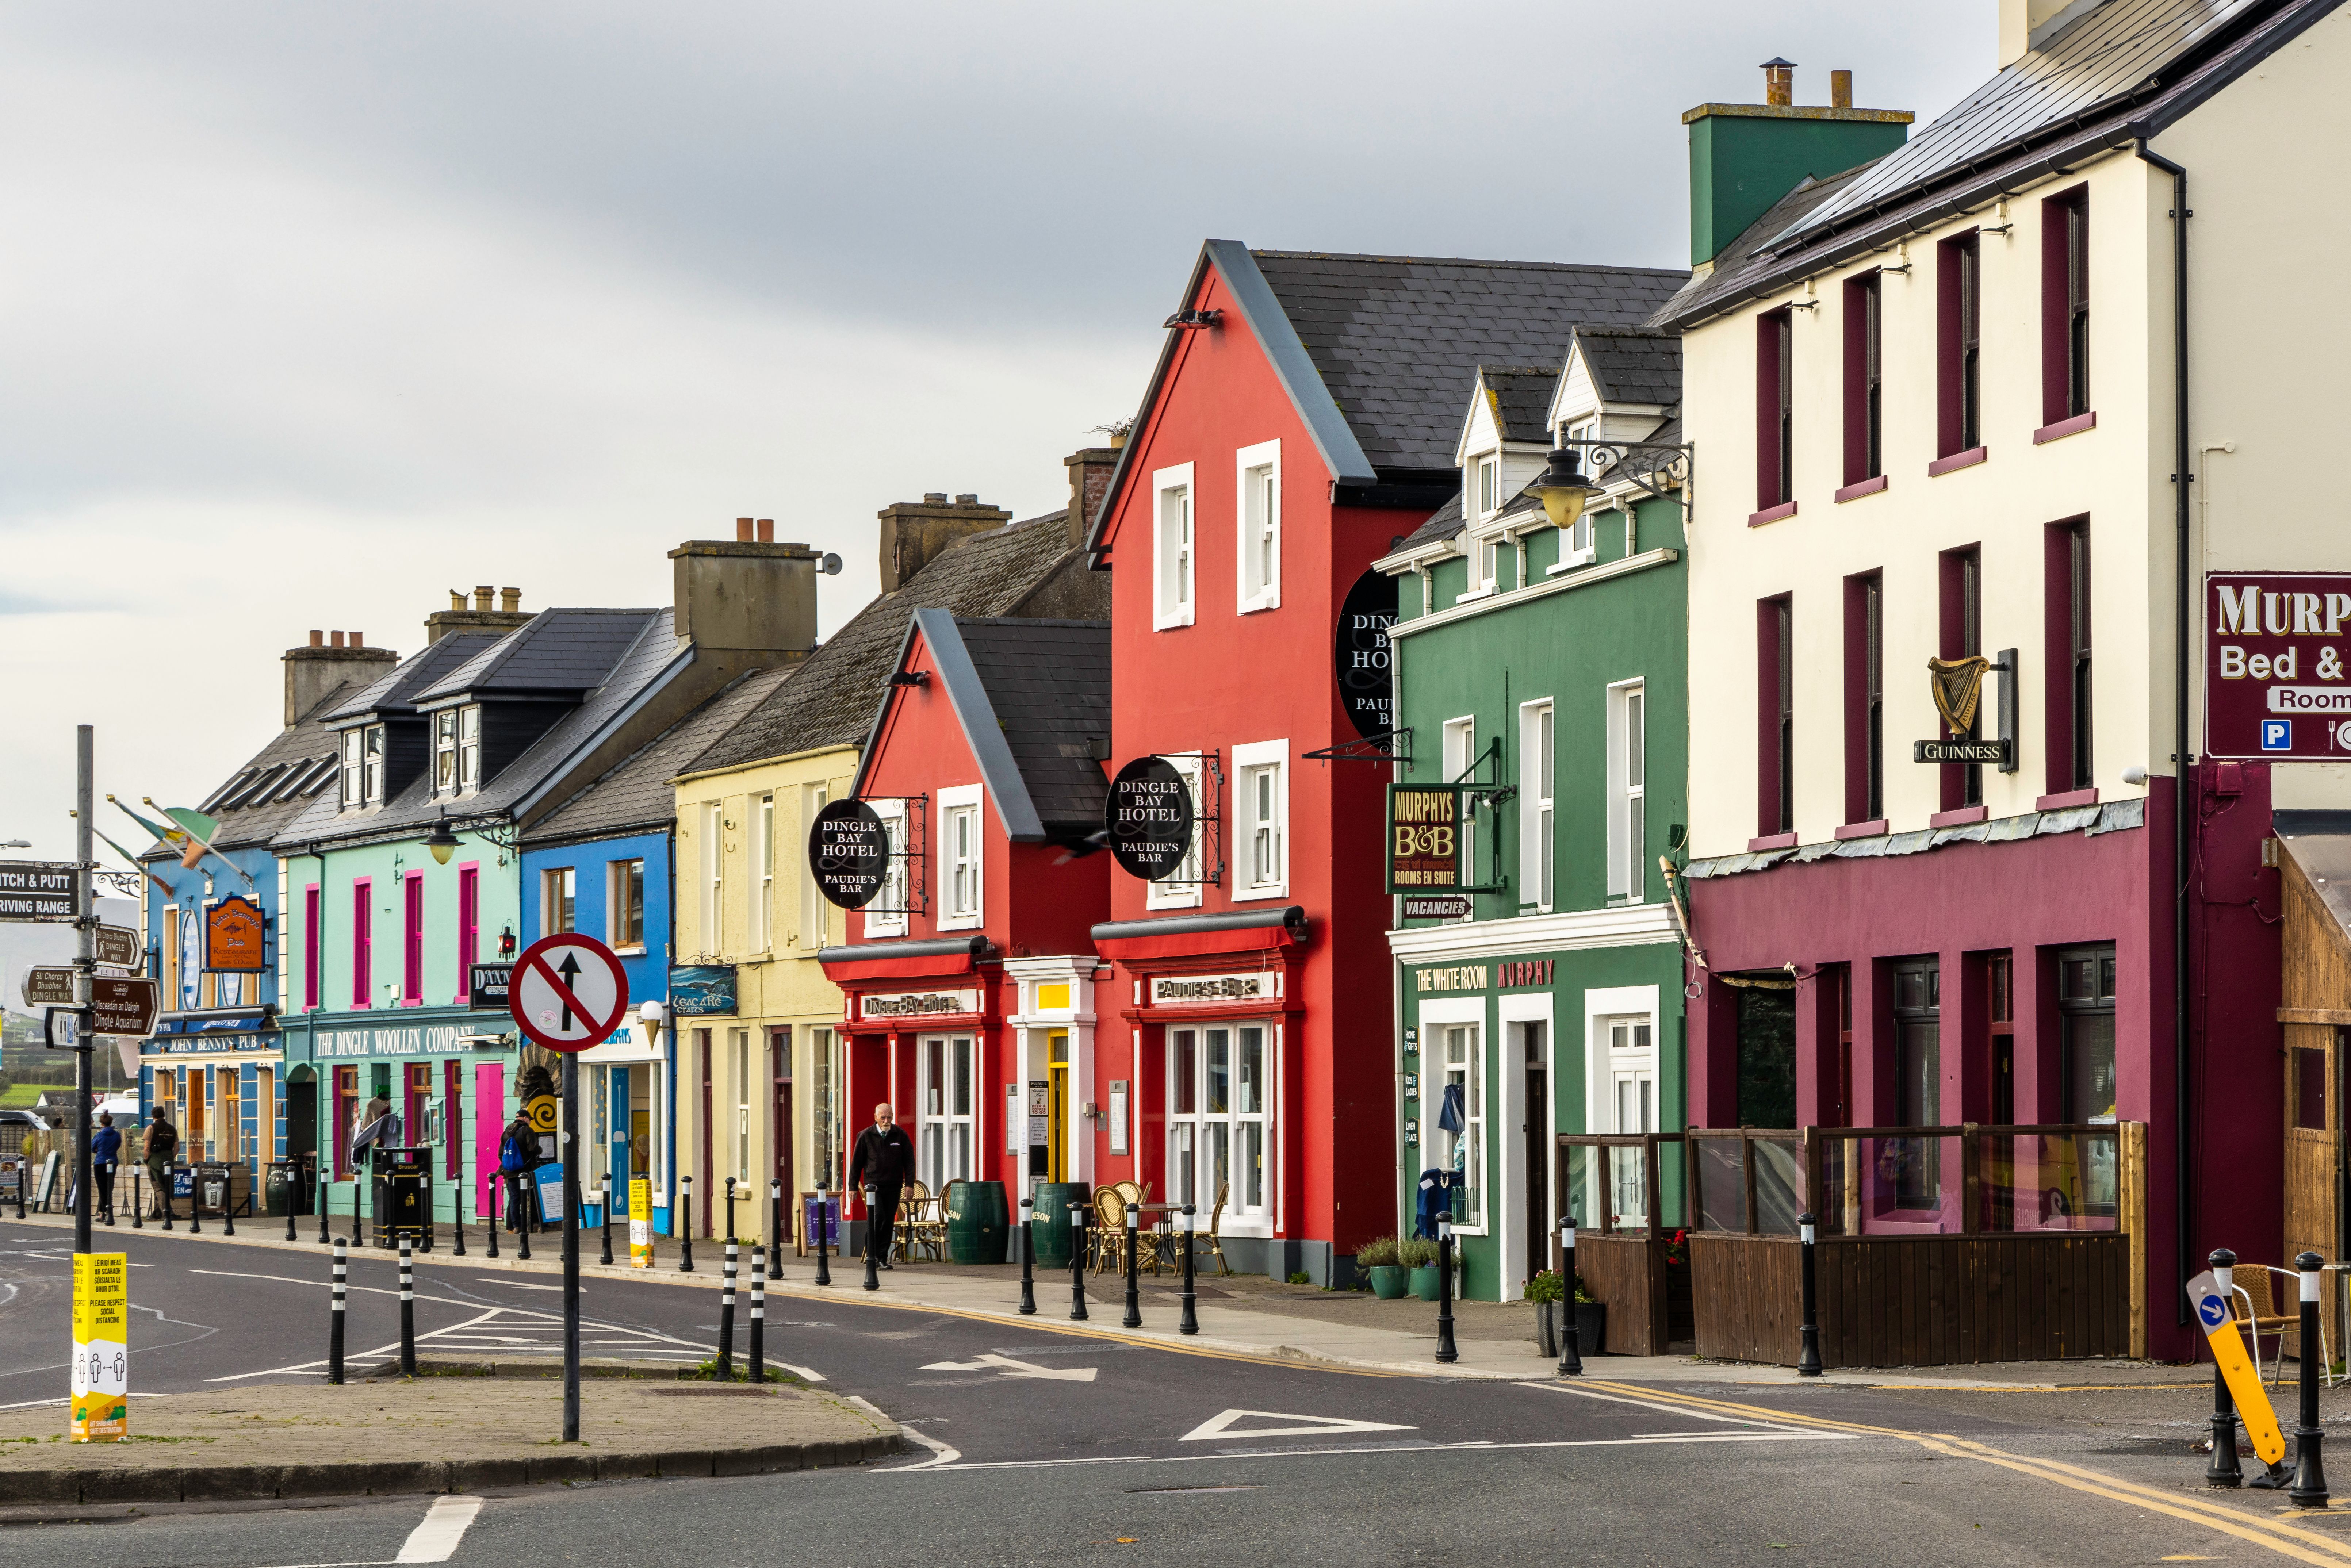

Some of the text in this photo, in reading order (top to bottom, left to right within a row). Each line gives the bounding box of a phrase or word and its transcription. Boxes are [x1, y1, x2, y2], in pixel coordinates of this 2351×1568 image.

[2216, 586, 2351, 635] MURP
[1352, 651, 1390, 668] HO
[2221, 646, 2344, 679] Bed &
[1968, 693, 1977, 709] 1759
[1925, 744, 2000, 759] GUINNESS
[1119, 782, 1179, 793] DINGLE
[1135, 795, 1163, 806] BAY
[1395, 792, 1453, 822] MURPHYS
[1118, 808, 1180, 821] HOTEL
[823, 821, 877, 832] DINGLE
[836, 833, 862, 843] BAY
[1395, 825, 1454, 857] B&B
[822, 845, 878, 857] HOTEL
[1121, 843, 1179, 852] PAUDIE'S
[1137, 854, 1163, 862] BAR
[29, 874, 37, 887] &
[41, 874, 70, 889] PUTT
[824, 875, 876, 884] PAUDIE'S
[1395, 871, 1454, 884] ROOMS EN SUITE
[840, 885, 862, 893] BAR
[36, 901, 70, 913] RANGE
[1406, 902, 1466, 914] VACANCIES
[106, 943, 125, 951] DINGLE
[110, 953, 121, 961] WAY
[45, 972, 63, 980] Chorca
[475, 970, 512, 989] DANN
[1416, 965, 1487, 992] THE WHITE ROOM
[1498, 959, 1554, 988] MURPHY
[1157, 978, 1253, 998] PAUDIE'S BAR
[32, 991, 72, 1001] DINGLE WAY
[125, 1001, 139, 1013] Daingin
[865, 994, 957, 1014] DINGLE BAY HOTEL
[95, 1013, 114, 1030] Dingle
[115, 1015, 142, 1030] Aquarium
[602, 1028, 631, 1044] RPHYS
[1405, 1030, 1415, 1039] HOME
[170, 1035, 257, 1051] JOHN BENNY'S PUB
[317, 1026, 475, 1057] THE DINGLE WOOLLEN COMPANY
[1408, 1042, 1417, 1051] GIFTS
[1406, 1088, 1417, 1096] LADIES
[1406, 1122, 1416, 1130] LINEN
[1408, 1133, 1417, 1141] LACE
